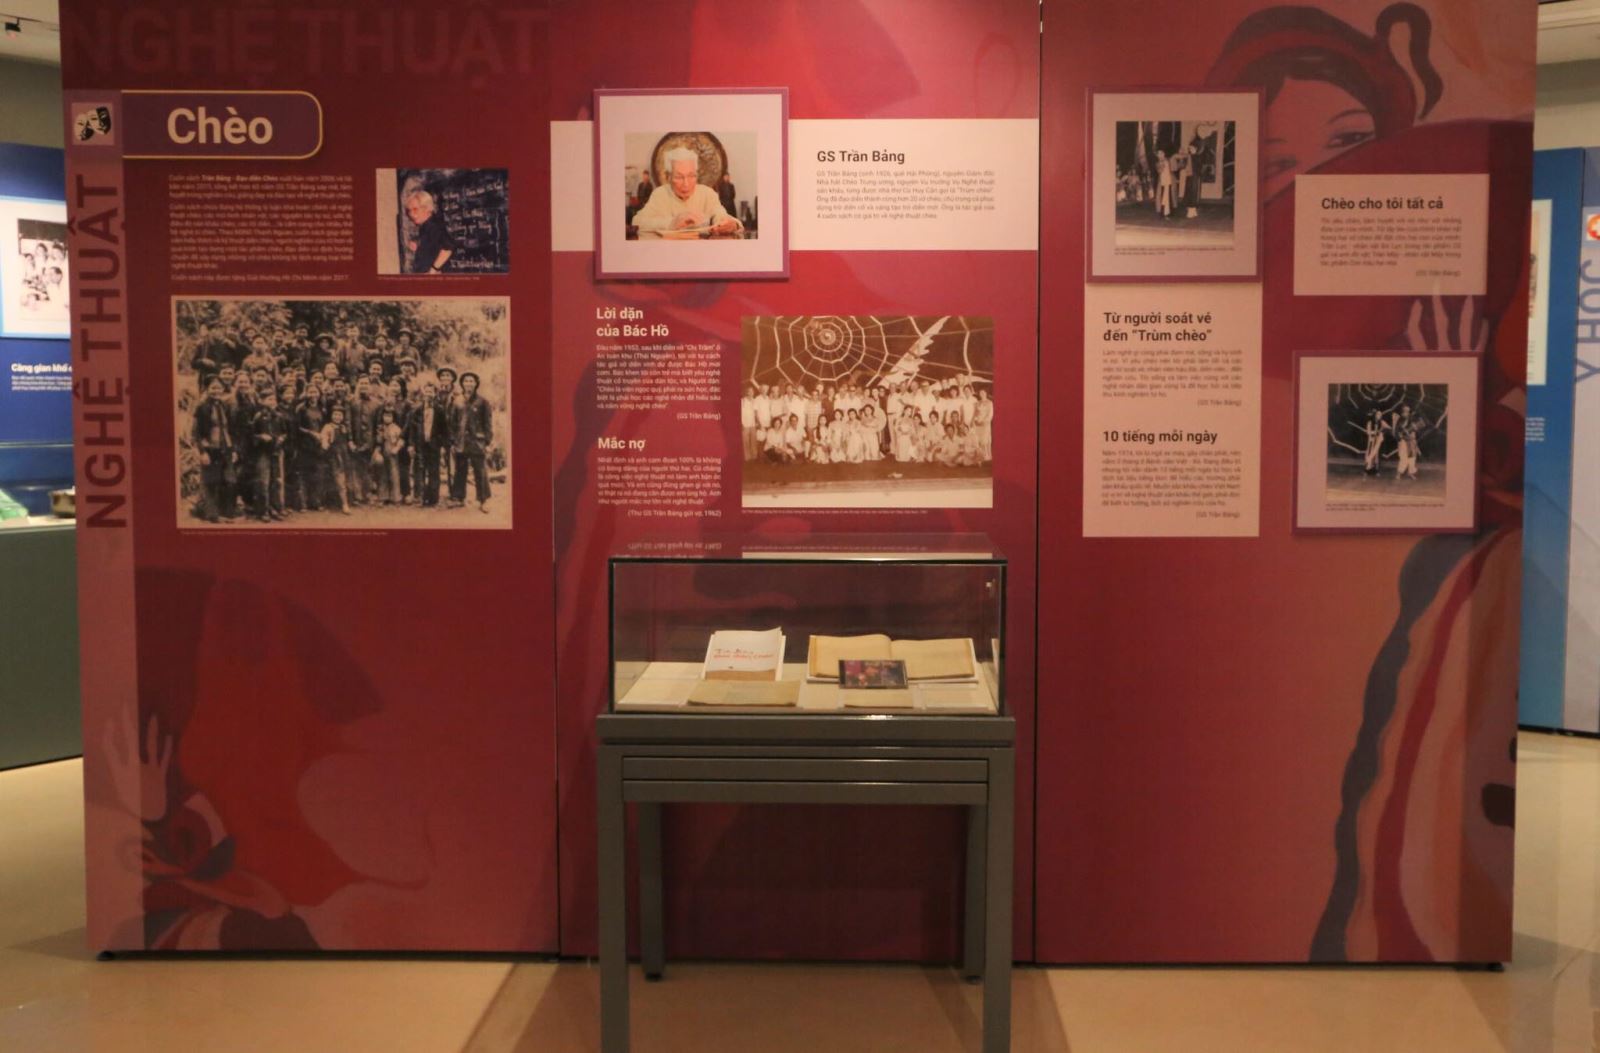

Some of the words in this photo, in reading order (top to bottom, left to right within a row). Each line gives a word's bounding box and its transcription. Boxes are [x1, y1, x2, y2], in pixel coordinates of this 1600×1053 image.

[167, 106, 273, 144] Chèo
[817, 150, 836, 162] GS
[839, 148, 868, 162] Trần
[872, 148, 905, 165] Bảng
[1321, 197, 1355, 209] Chèo
[1358, 197, 1383, 209] cho
[1386, 197, 1403, 209] tôi
[1407, 196, 1425, 209] tất
[1428, 196, 1444, 209] cả
[67, 174, 127, 362] THUẬT
[596, 307, 617, 320] Lời
[620, 306, 644, 322] dặn
[1103, 311, 1121, 324] Từ
[1124, 312, 1162, 327] người
[1165, 312, 1194, 324] soát
[1197, 312, 1212, 324] vé
[596, 323, 620, 337] của
[623, 324, 648, 337] Bác
[651, 323, 670, 337] Hồ
[1103, 328, 1129, 341] đến
[598, 436, 626, 449] Mắc
[629, 438, 646, 452] nợ
[1103, 430, 1119, 442] 10
[1122, 429, 1156, 445] tiếng
[1186, 430, 1218, 445] ngày
[73, 377, 134, 528] NGHỆ
